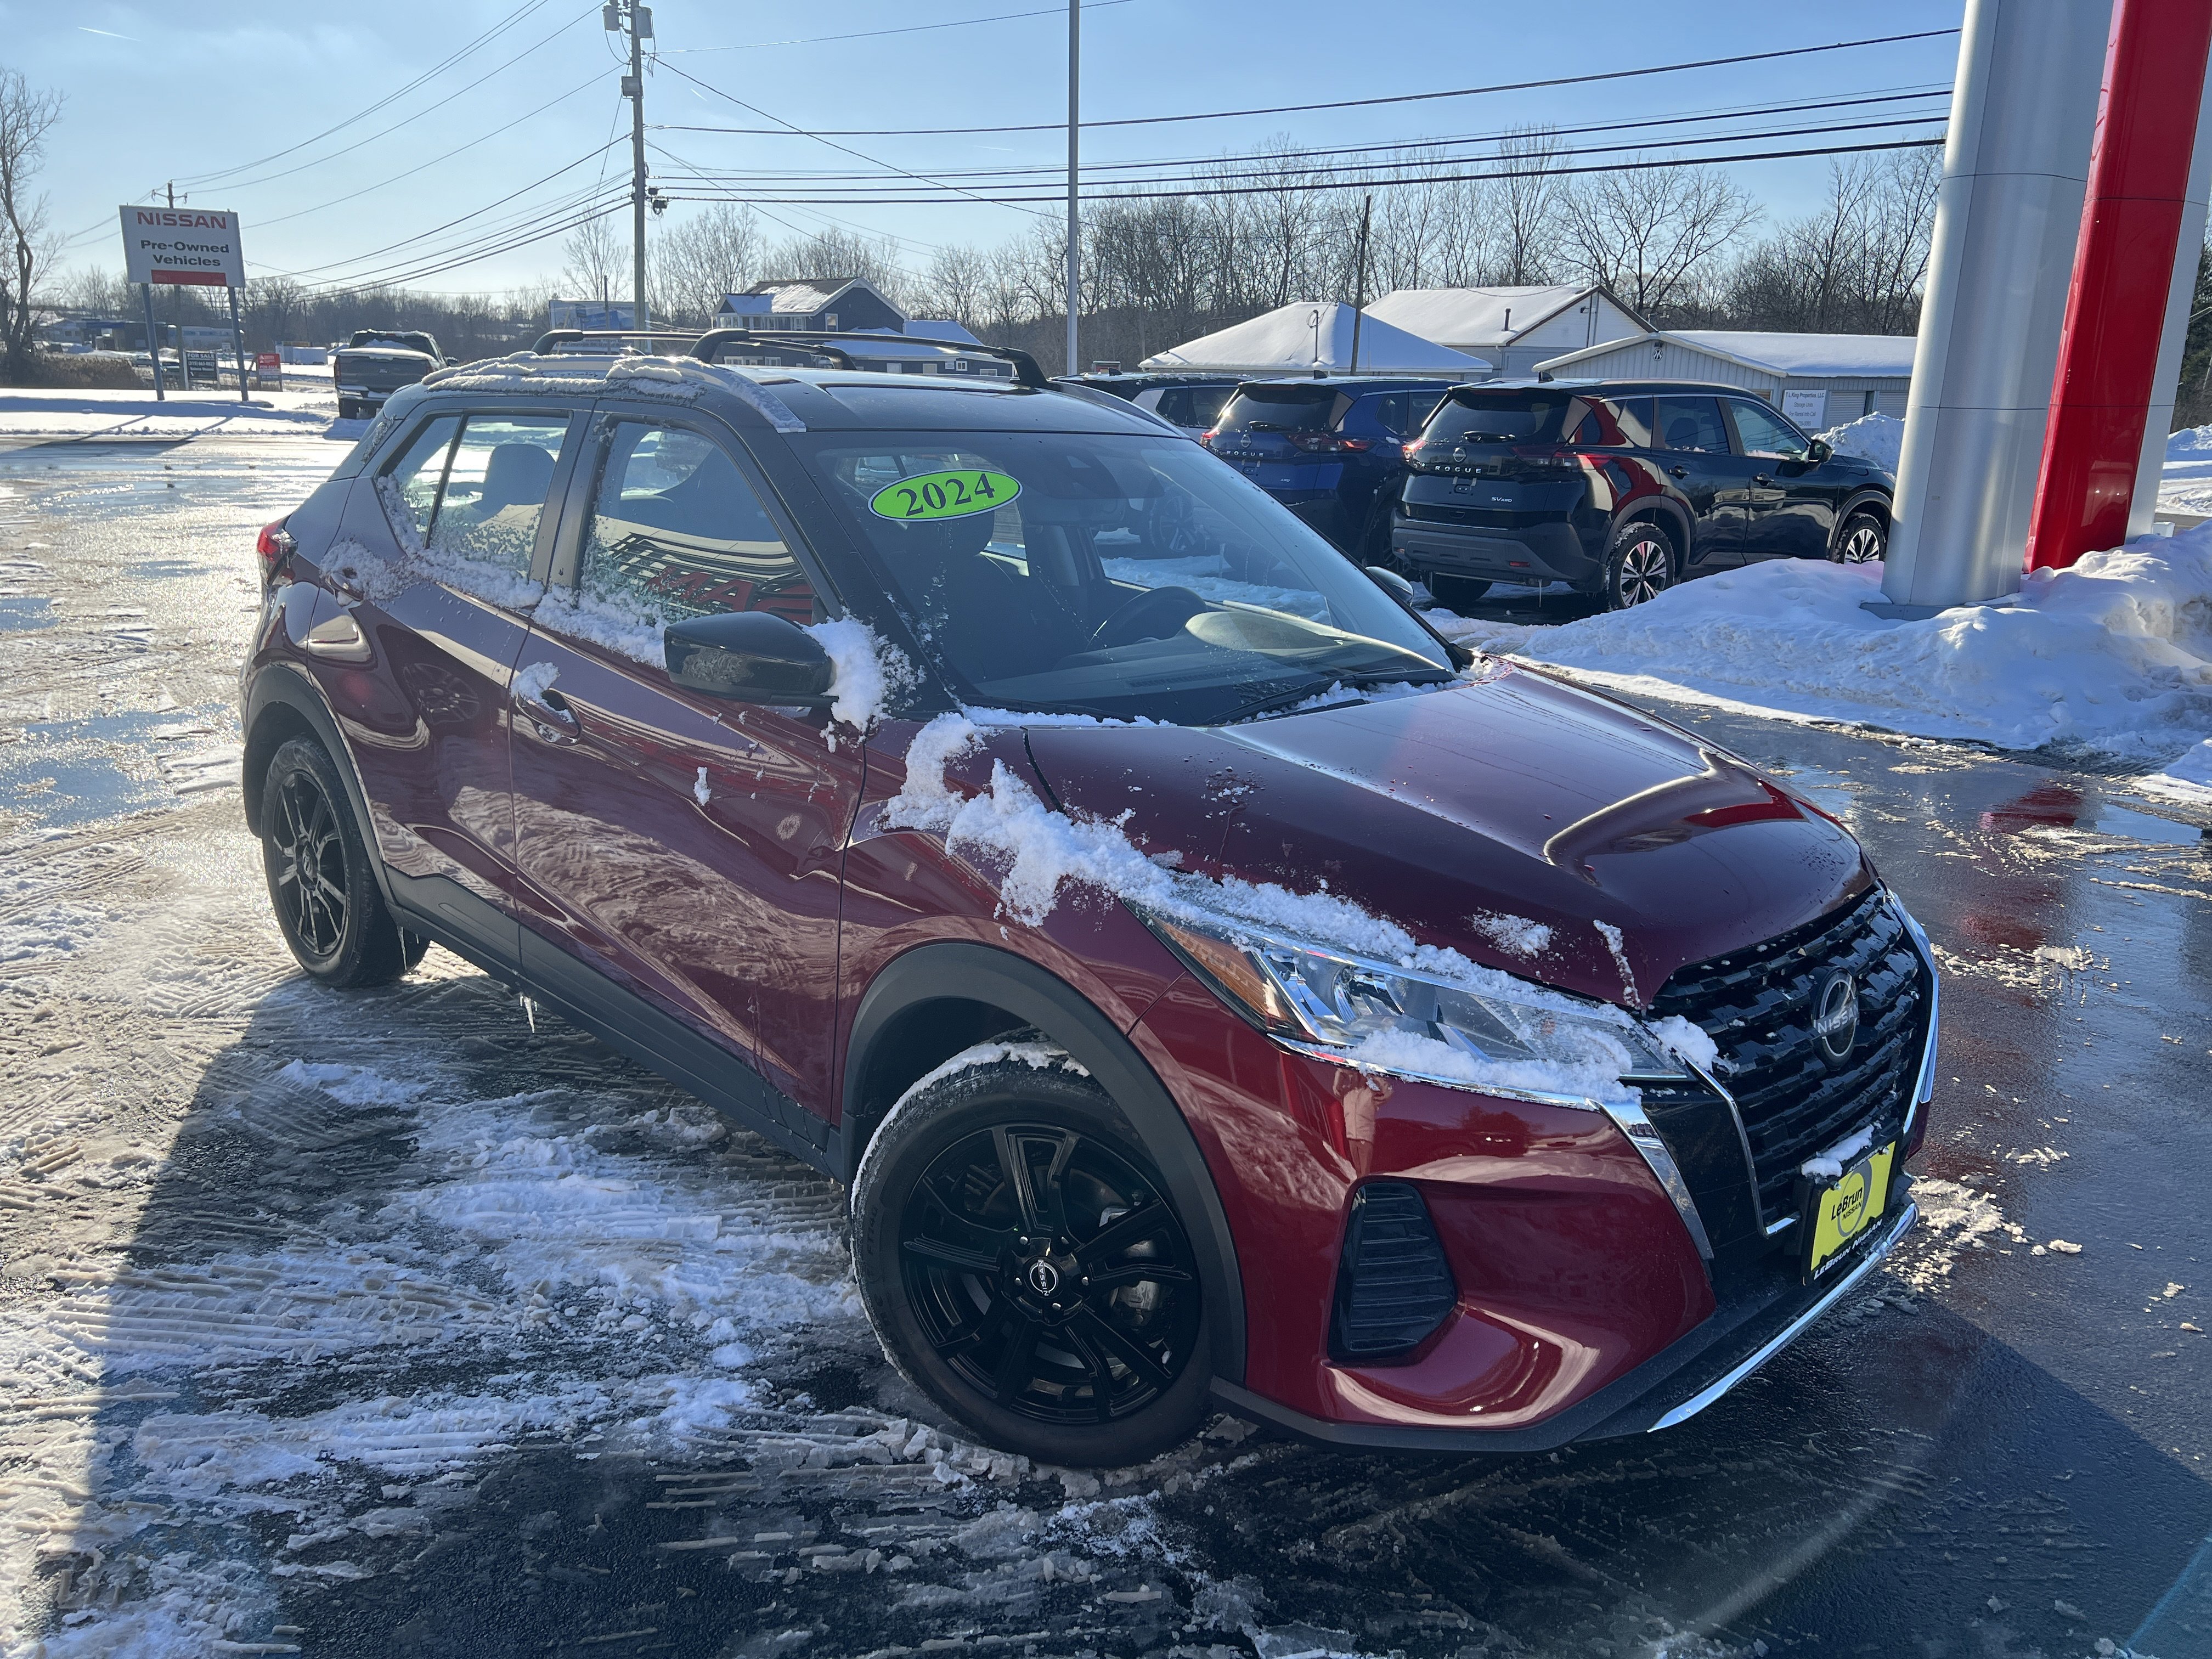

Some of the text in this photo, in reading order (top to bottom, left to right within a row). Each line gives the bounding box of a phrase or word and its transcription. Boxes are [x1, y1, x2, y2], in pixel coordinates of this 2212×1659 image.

[137, 212, 226, 229] NISSAN
[140, 240, 229, 253] Pre-Owned
[153, 255, 221, 266] Vehicles
[1435, 466, 1482, 474] ROGUE
[896, 473, 995, 517] 2024
[1818, 1004, 1859, 1034] NISSAN
[1831, 1187, 1863, 1221] LeBrun
[1842, 1200, 1863, 1221] NISSAN
[1037, 1260, 1049, 1296] NISSAN
